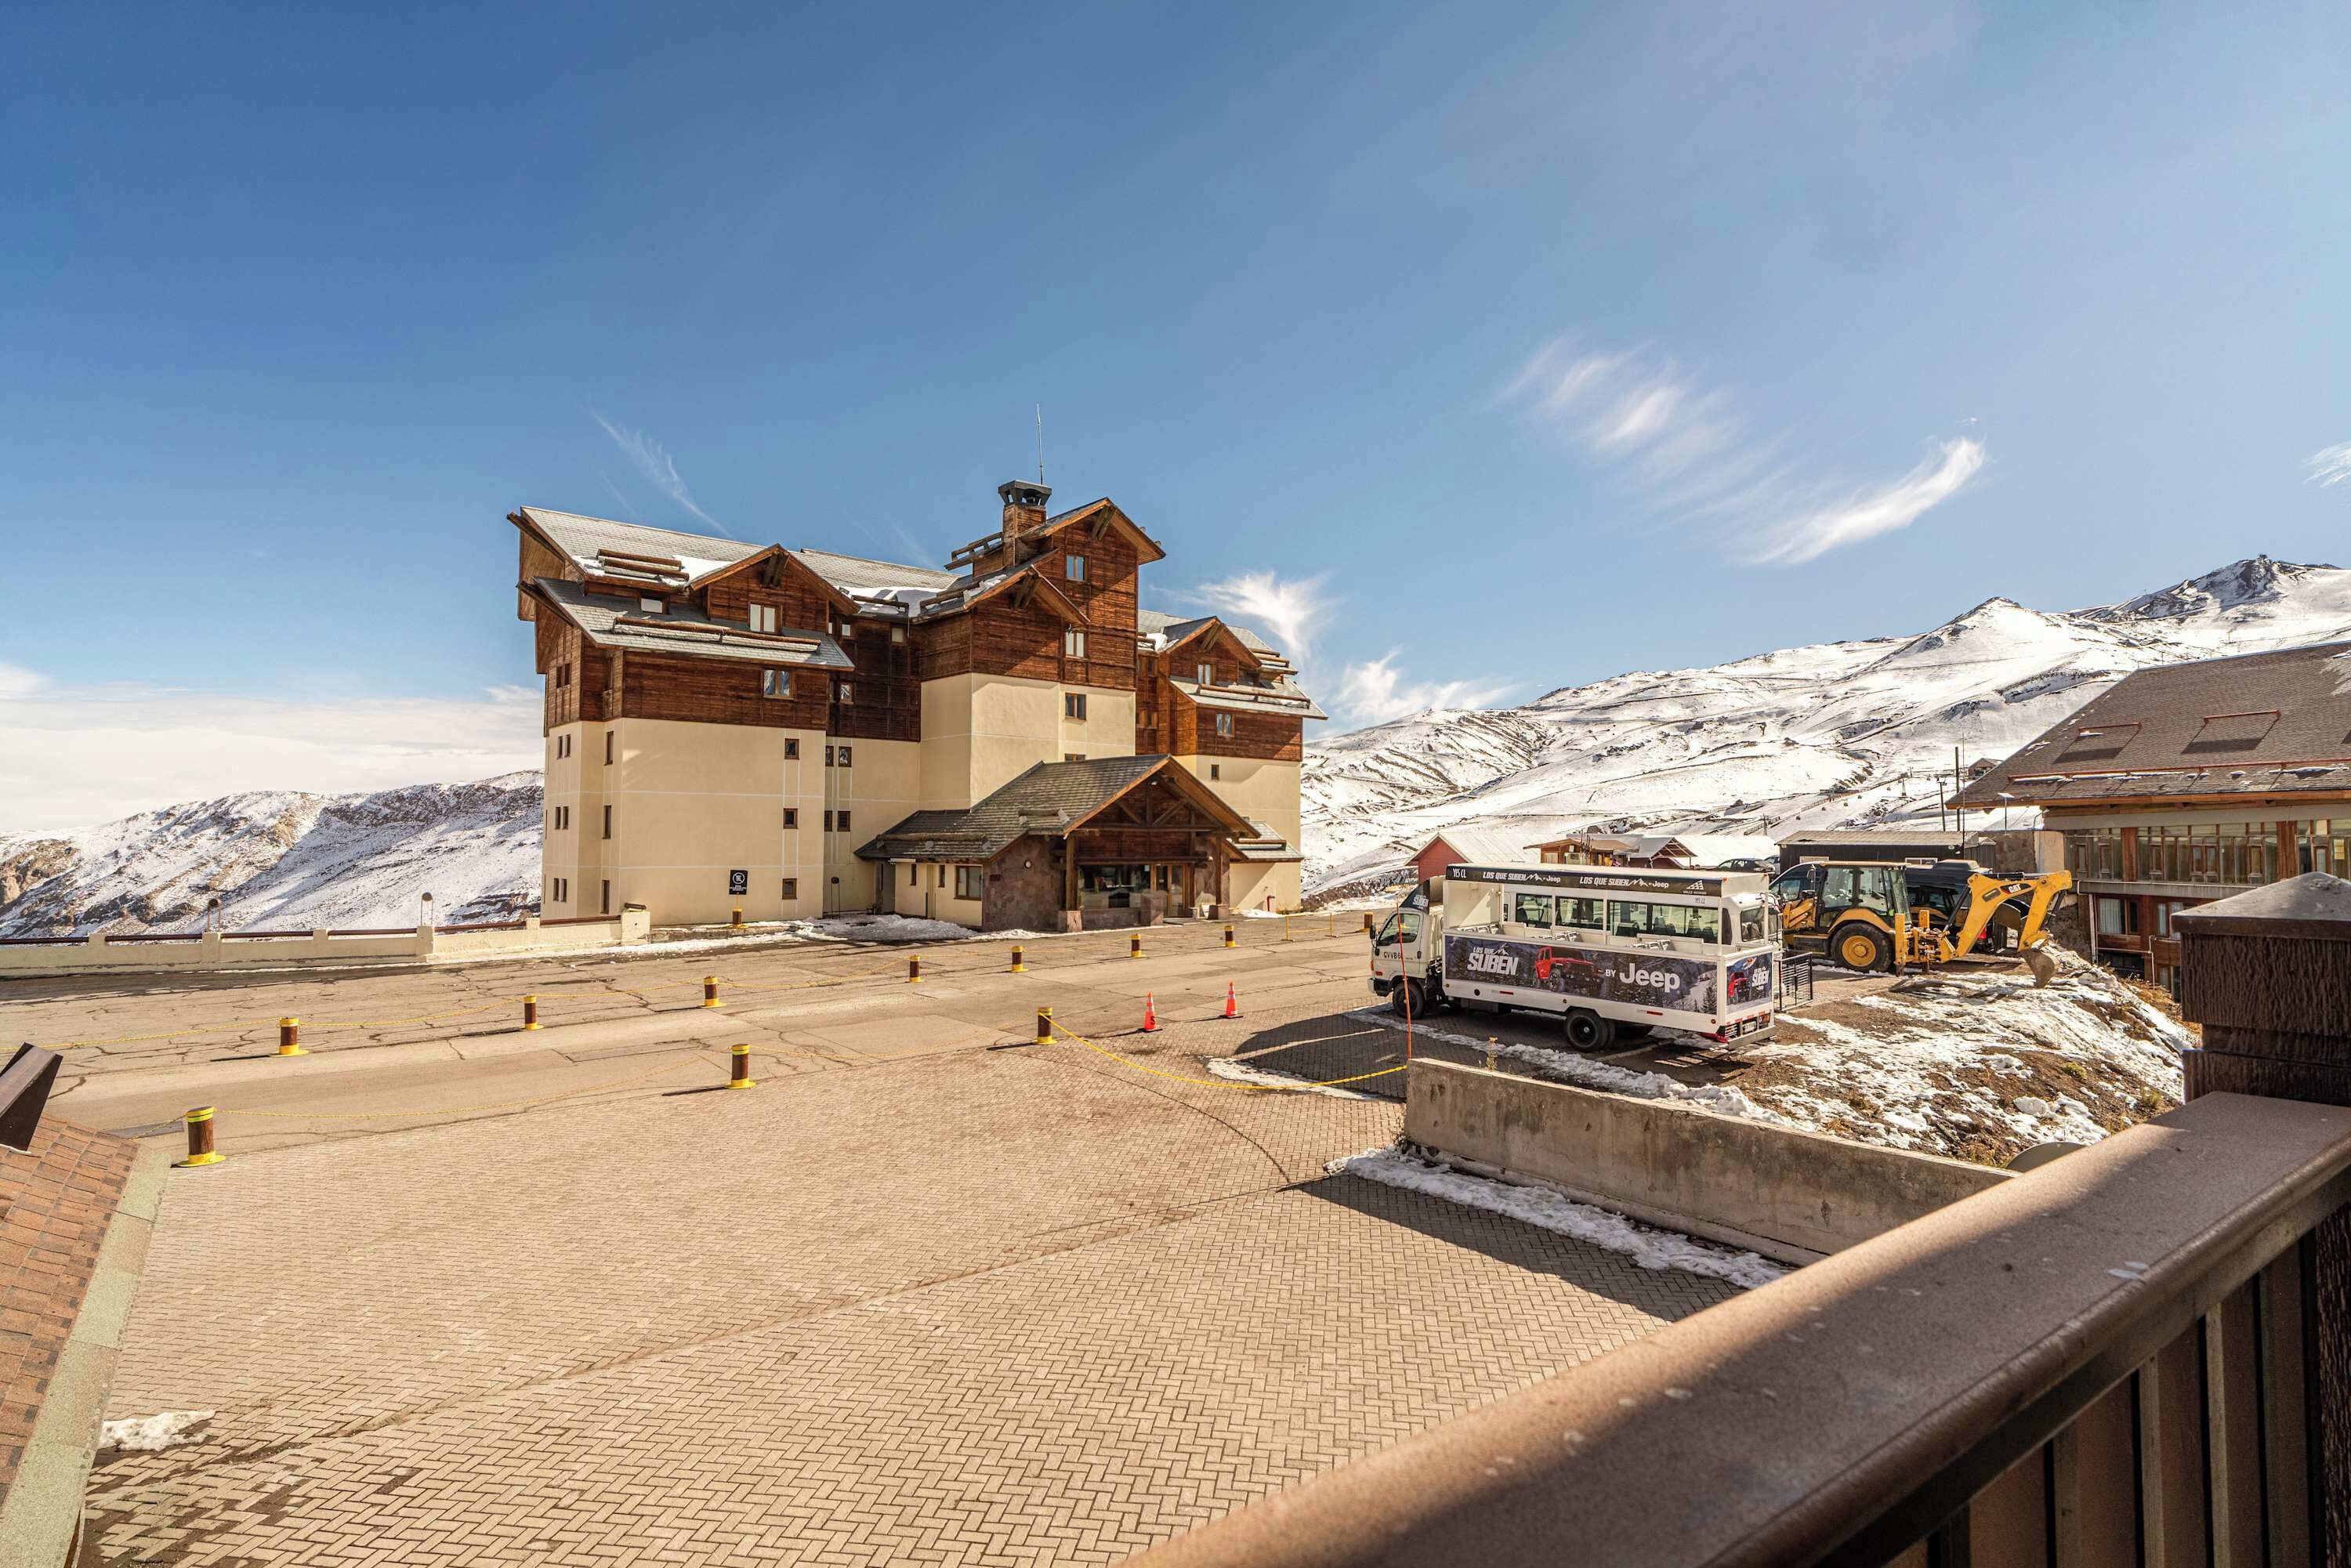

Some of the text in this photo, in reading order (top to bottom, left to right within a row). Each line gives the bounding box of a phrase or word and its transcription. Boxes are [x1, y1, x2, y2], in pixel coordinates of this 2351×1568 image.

[1495, 872, 1508, 881] QUE
[1594, 877, 1607, 885] QUE
[1653, 880, 1669, 889] Jeep
[2009, 884, 2021, 893] CAT
[1467, 953, 1519, 976] SUBEN
[1619, 963, 1680, 993] Jeep
